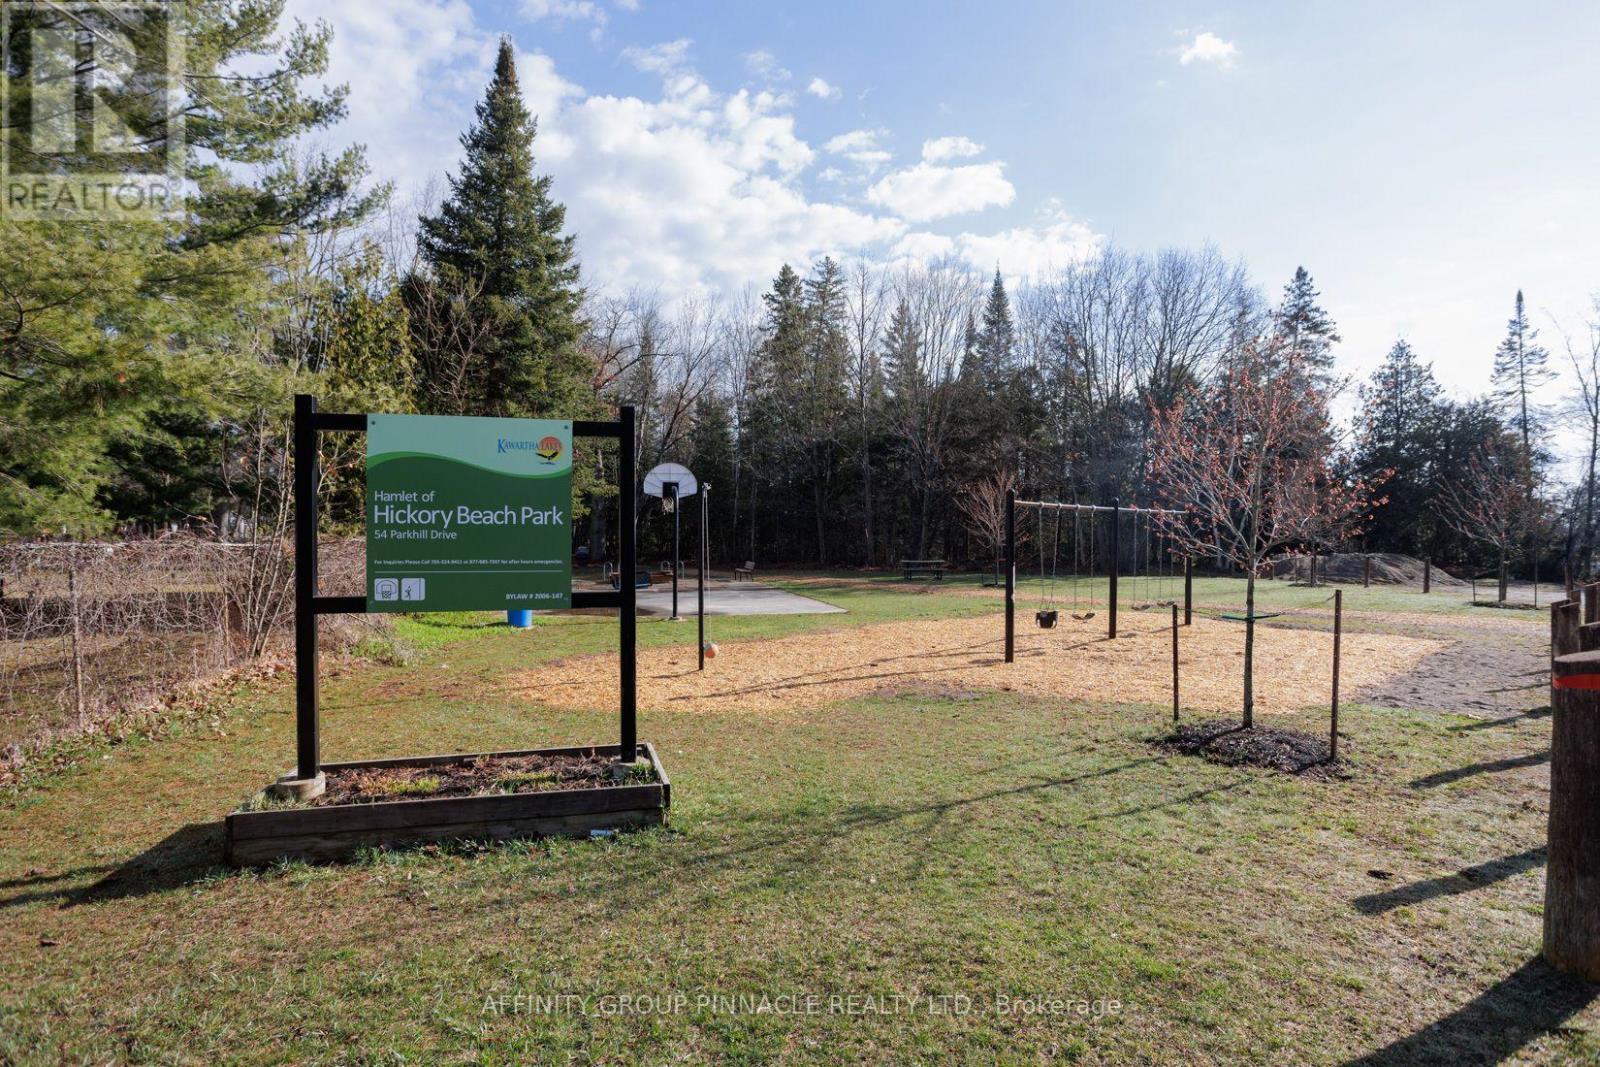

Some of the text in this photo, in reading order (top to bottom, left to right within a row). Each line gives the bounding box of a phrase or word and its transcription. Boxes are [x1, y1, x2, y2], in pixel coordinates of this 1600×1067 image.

[374, 490, 436, 502] Hamlet of
[374, 504, 564, 529] Hickory Beach Park
[374, 529, 457, 540] 54 Parkhill Drive
[505, 592, 528, 600] BYLAW
